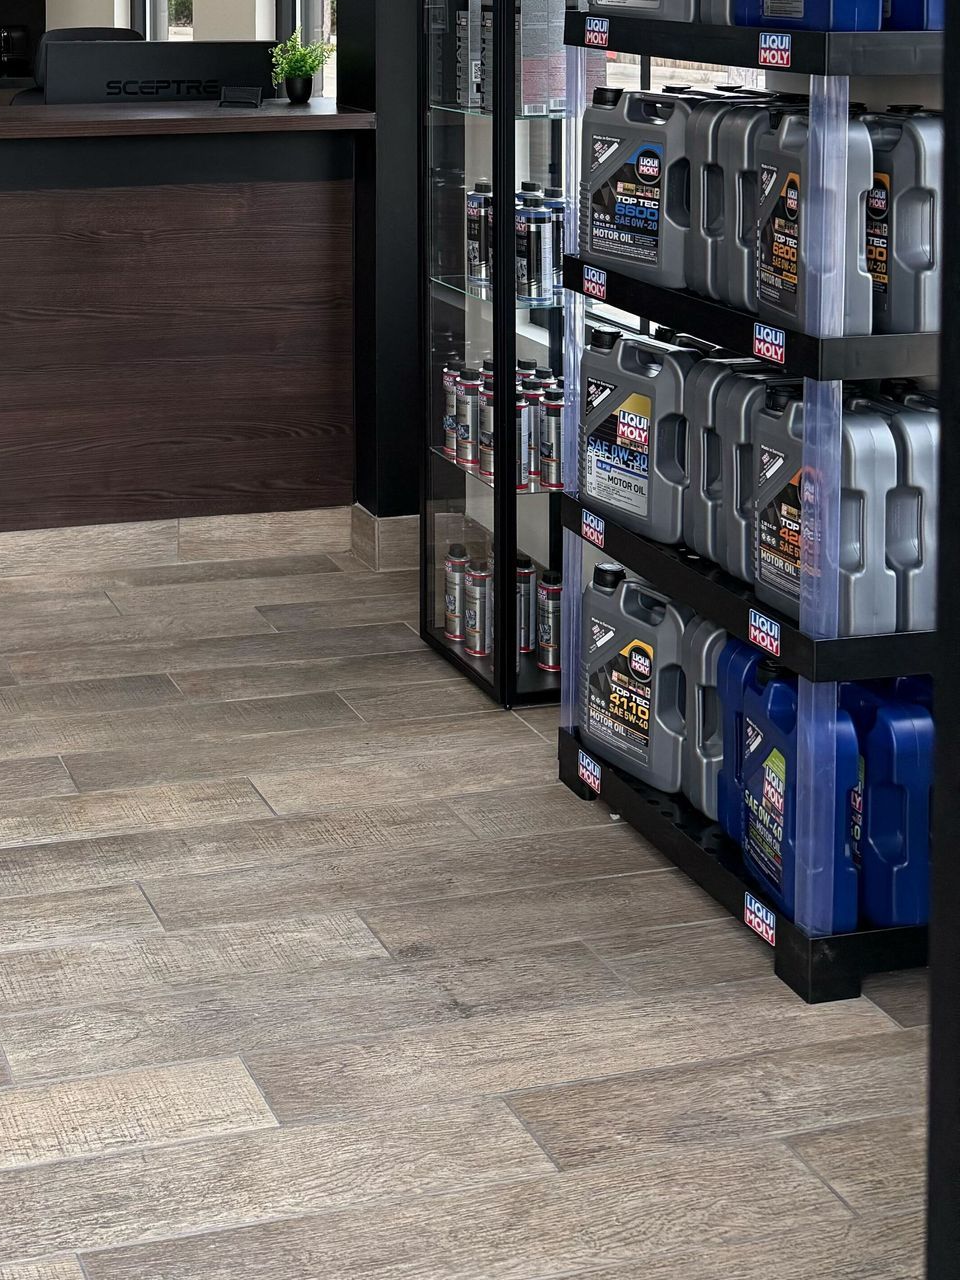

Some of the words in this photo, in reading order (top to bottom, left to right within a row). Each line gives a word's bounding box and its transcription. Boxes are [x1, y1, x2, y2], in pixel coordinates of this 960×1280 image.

[587, 19, 608, 33] LIQUI
[586, 31, 608, 45] MOLY
[761, 34, 789, 50] LIQUI
[760, 48, 789, 64] MOLY
[106, 79, 221, 96] SCEPTRE
[639, 166, 658, 176] MOLY
[640, 157, 658, 167] LIQUI
[616, 195, 637, 205] TOP
[639, 199, 659, 209] TEC
[615, 203, 658, 221] 6600
[615, 215, 630, 226] SAE
[631, 218, 658, 231] 0W-20
[593, 227, 619, 241] MOTOR
[620, 232, 634, 244] OIL
[774, 233, 786, 243] TOP
[786, 236, 798, 247] TEC
[868, 236, 887, 247] TEC
[773, 242, 798, 262] 6200
[867, 247, 887, 261] 00
[772, 257, 782, 269] SAE
[585, 267, 605, 285] LIQUI
[584, 280, 605, 297] MOLY
[755, 325, 783, 346] LIQUI
[755, 339, 783, 361] MOLY
[620, 411, 647, 430] LIQUI
[619, 425, 648, 443] MOLY
[588, 436, 609, 453] SAE
[611, 445, 648, 466] 0W-30
[607, 474, 632, 491] MOTOR
[633, 483, 647, 496] OIL
[583, 511, 603, 533] LIQUI
[780, 517, 800, 531] TOP
[583, 522, 603, 545] MOLY
[779, 541, 794, 556] SAE
[760, 549, 784, 569] MOTOR
[784, 562, 797, 576] OIL
[751, 611, 778, 639] LIQUI
[751, 626, 778, 653] MOLY
[631, 659, 649, 677] MOLY
[632, 651, 649, 667] LIQUI
[610, 683, 630, 698] TOP
[630, 693, 650, 709] TEC
[609, 692, 649, 721] 4110
[589, 707, 613, 730] MOTOR
[613, 721, 627, 737] OIL
[609, 703, 624, 719] SAE
[624, 711, 649, 731] 5W-40
[580, 752, 600, 778] LIQUI
[580, 763, 600, 790] MOLY
[766, 765, 784, 795] LIQUI
[764, 779, 784, 810] MOLY
[744, 789, 759, 815] SAE
[758, 806, 783, 842] 0W-40
[756, 820, 773, 845] MOTOR
[746, 894, 774, 928] LIQUI
[746, 908, 774, 941] MOLY
